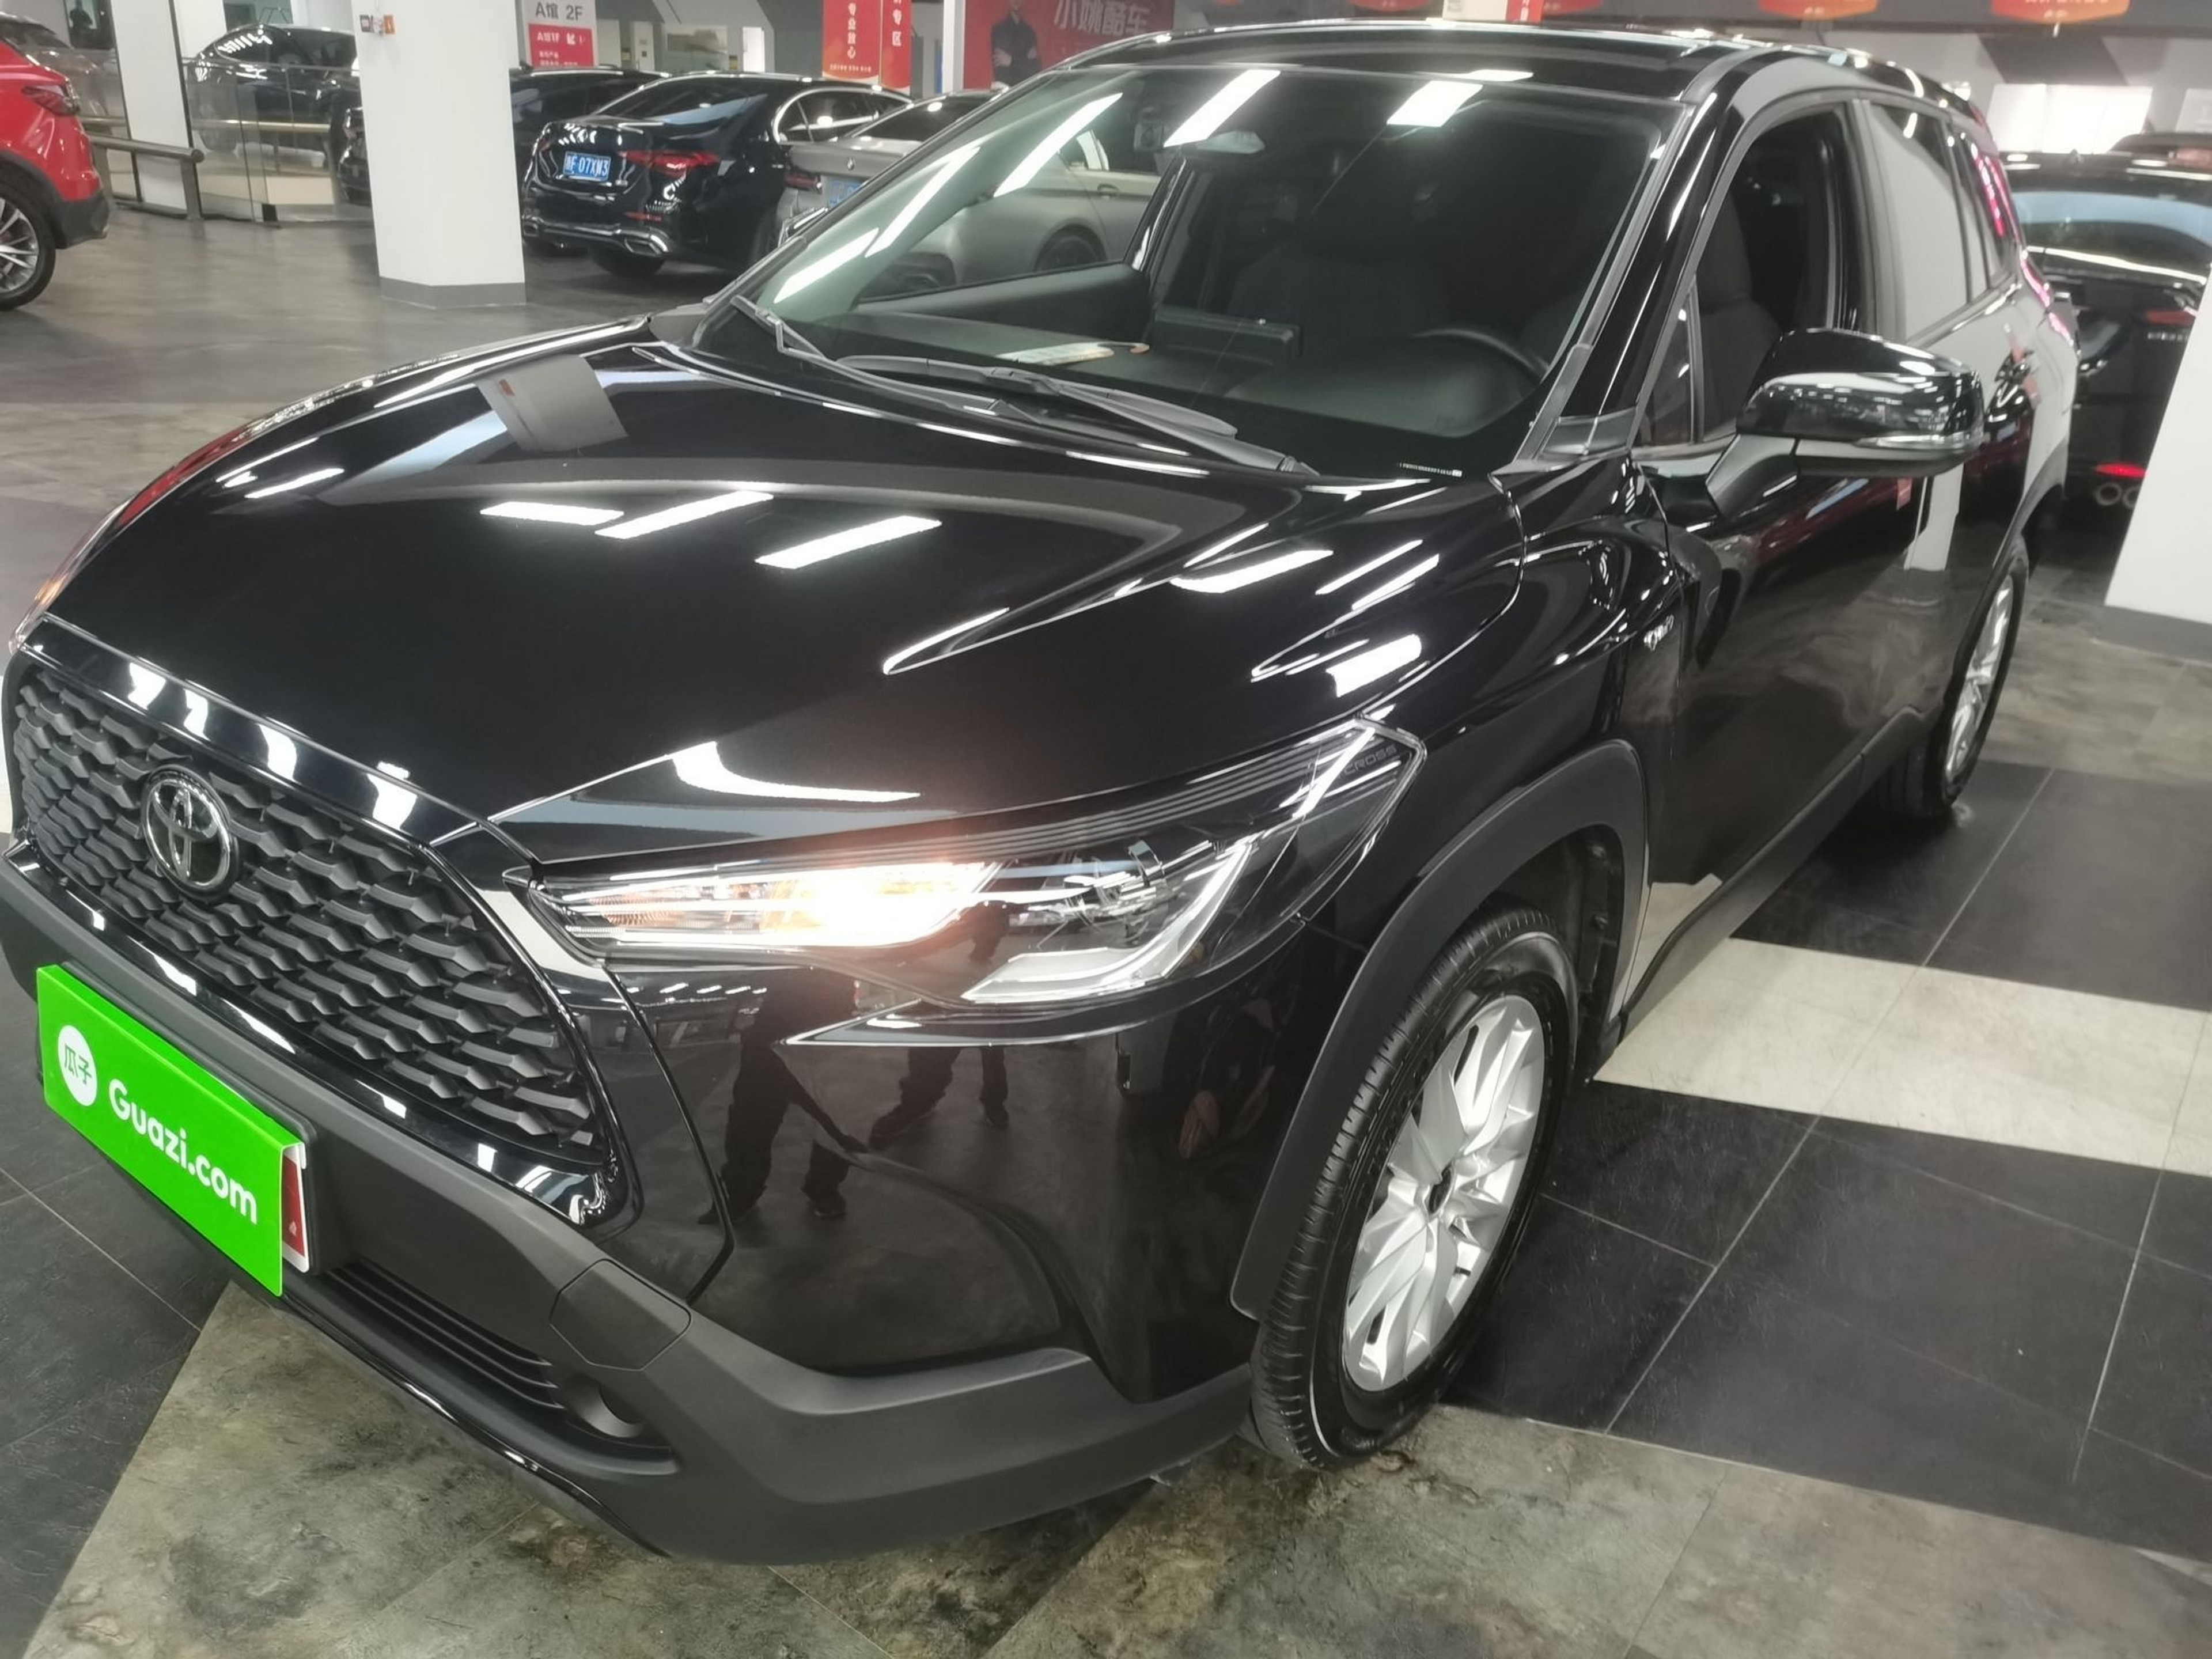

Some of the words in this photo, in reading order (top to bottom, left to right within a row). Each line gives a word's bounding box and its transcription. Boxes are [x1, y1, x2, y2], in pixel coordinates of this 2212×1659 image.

[566, 5, 583, 21] 2F
[892, 0, 902, 47] 专区
[64, 1044, 92, 1085] 瓜子
[108, 1078, 257, 1225] Guazi.com
